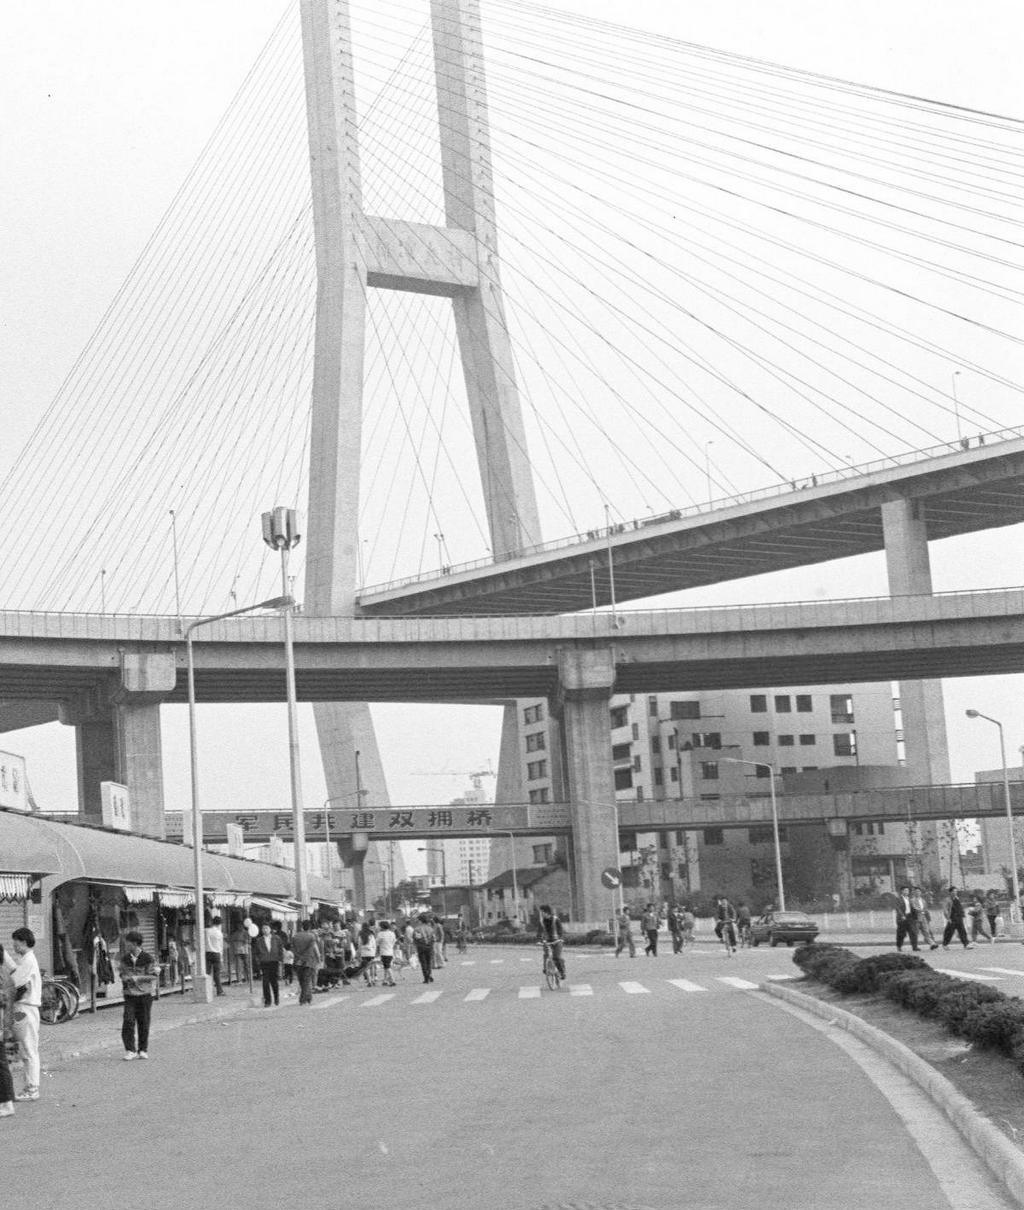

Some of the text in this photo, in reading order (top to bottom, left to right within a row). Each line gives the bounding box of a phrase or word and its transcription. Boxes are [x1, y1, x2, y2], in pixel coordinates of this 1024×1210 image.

[236, 810, 492, 831] 军民共建双拥桥
